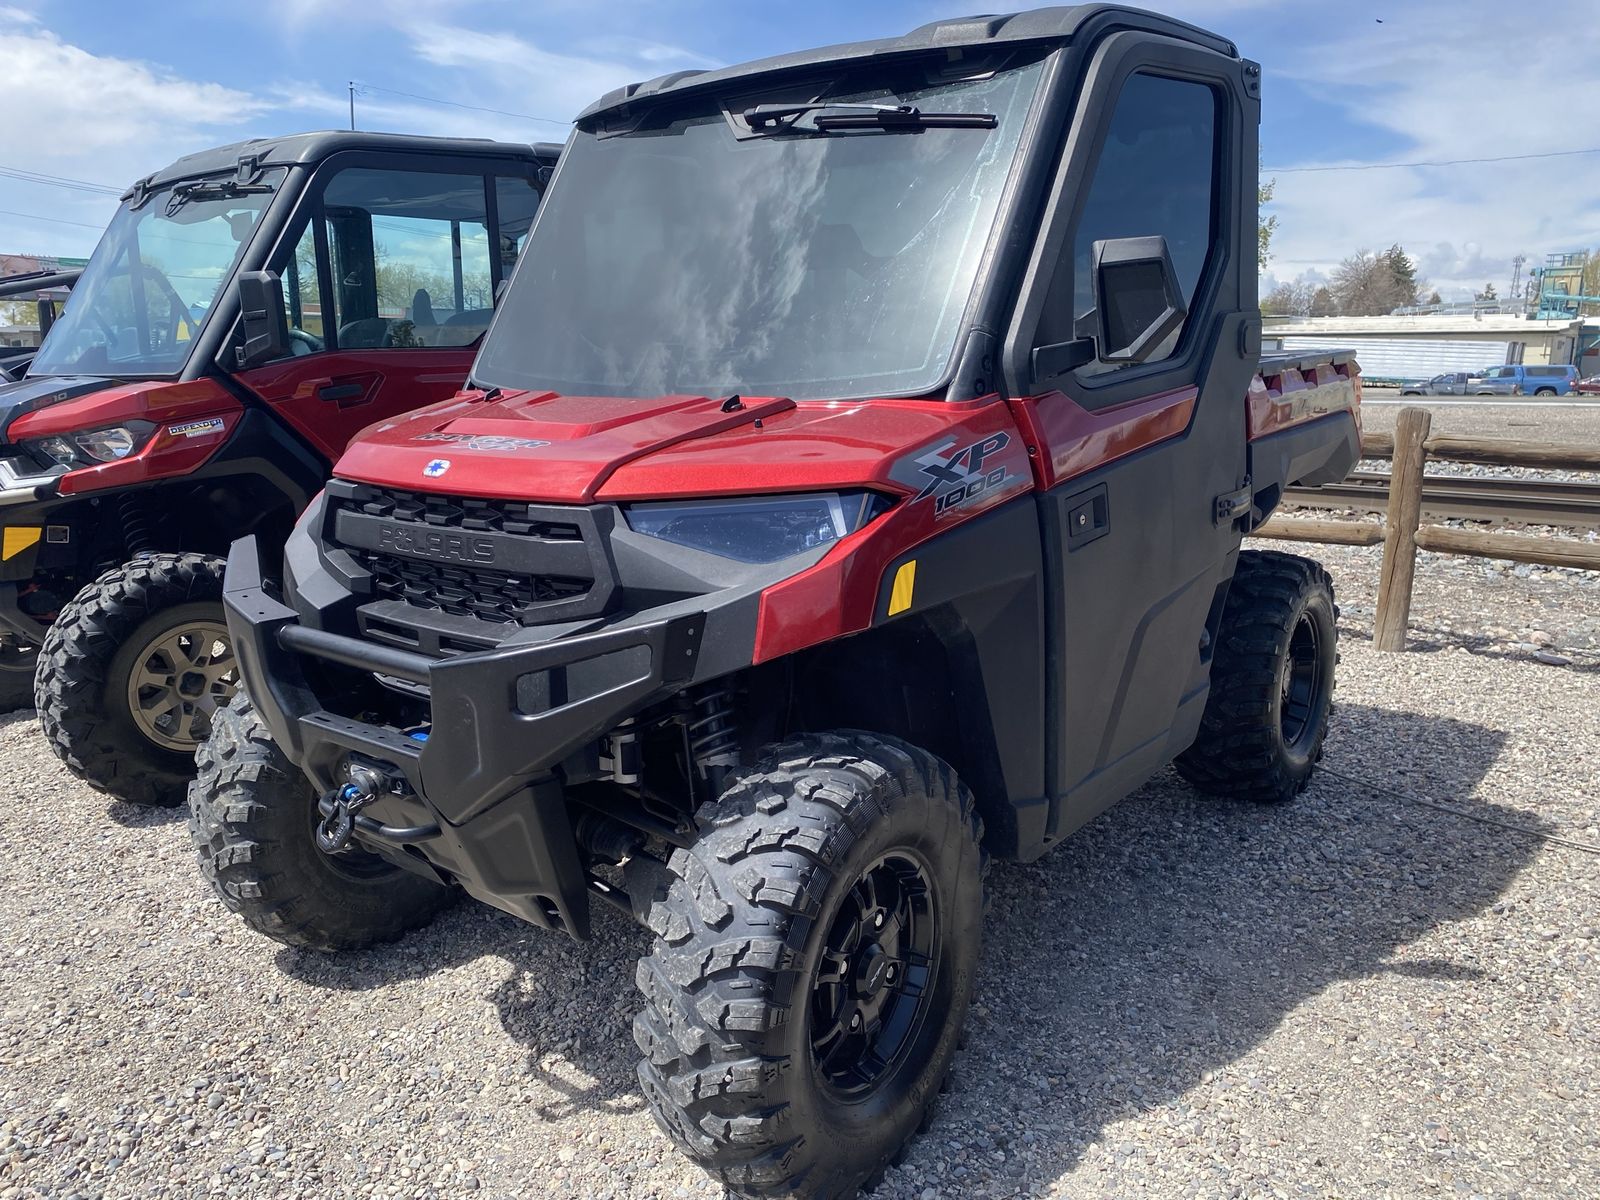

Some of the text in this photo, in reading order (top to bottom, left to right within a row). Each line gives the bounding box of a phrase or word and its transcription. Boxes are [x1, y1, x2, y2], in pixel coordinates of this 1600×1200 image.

[170, 418, 223, 434] DEFENDER
[909, 431, 1011, 505] XP
[935, 466, 1006, 515] 1000
[379, 525, 495, 563] POLARIS
